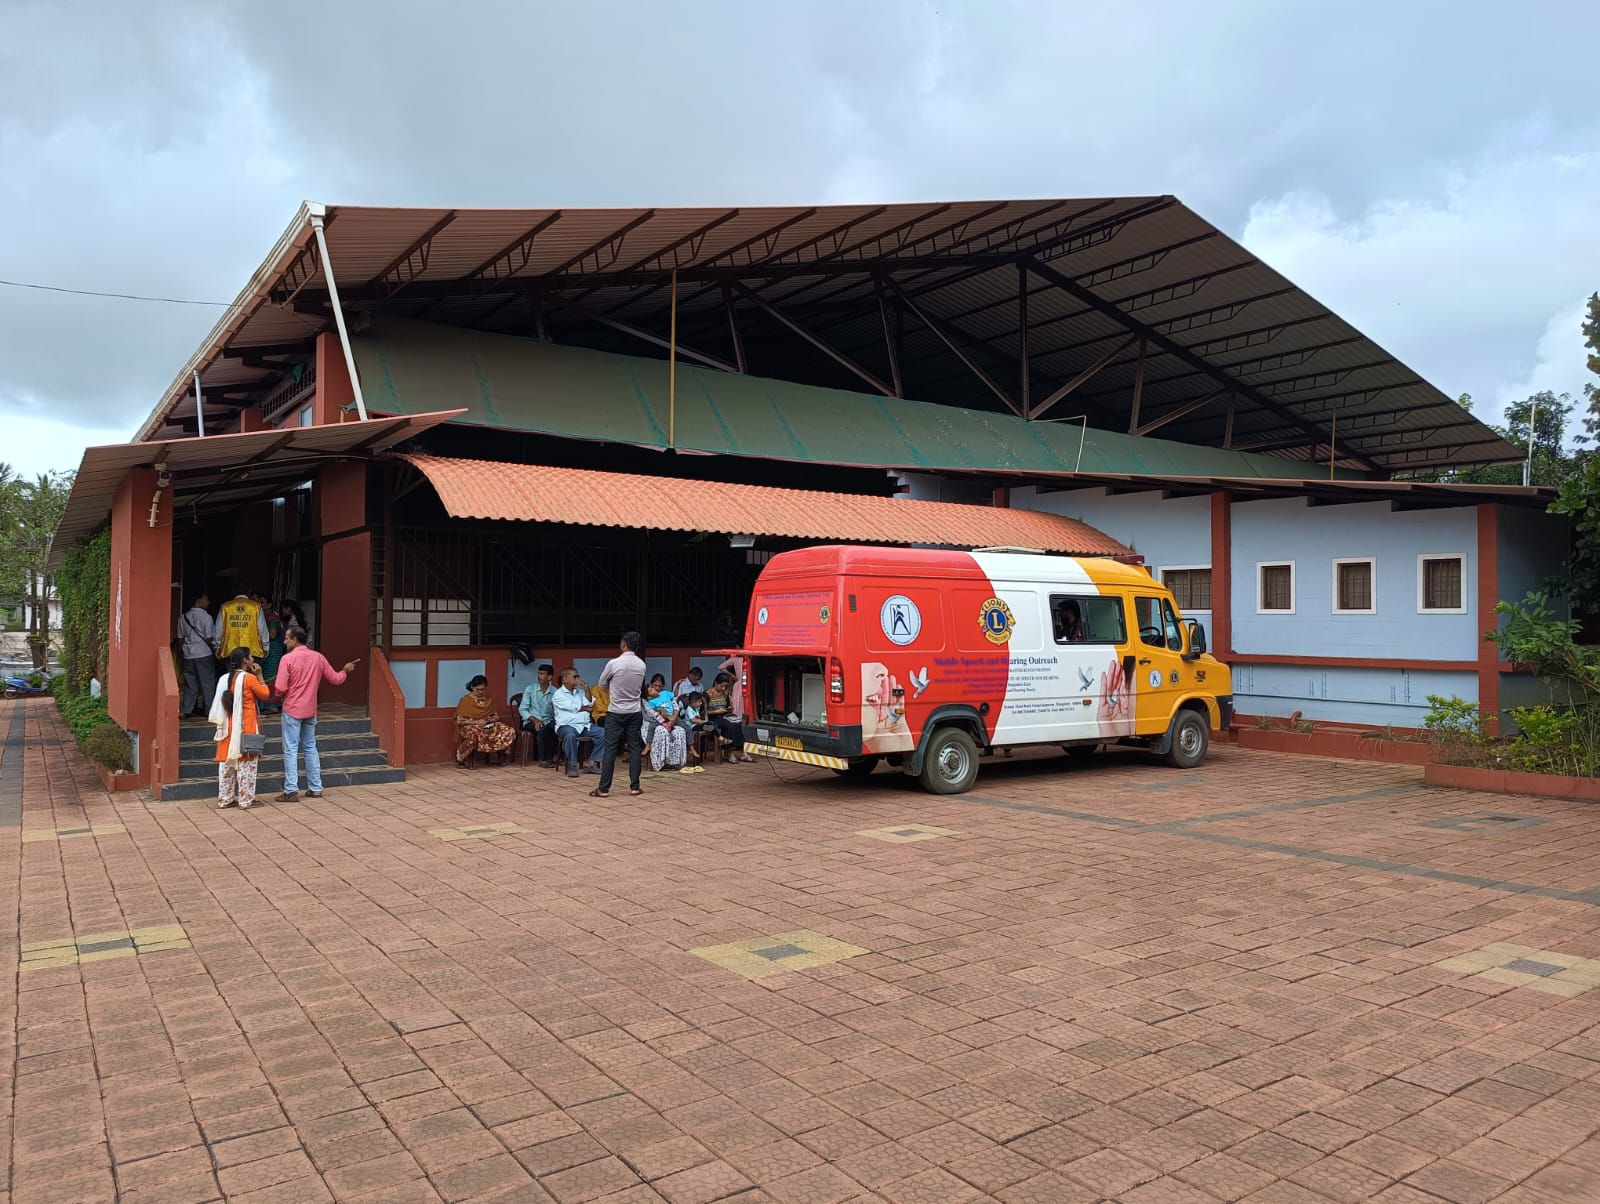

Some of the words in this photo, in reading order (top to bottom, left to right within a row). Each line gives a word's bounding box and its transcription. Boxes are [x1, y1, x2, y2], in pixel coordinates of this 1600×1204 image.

[984, 599, 1006, 610] LIONS
[991, 612, 1003, 629] L
[1028, 656, 1059, 665] Outreach
